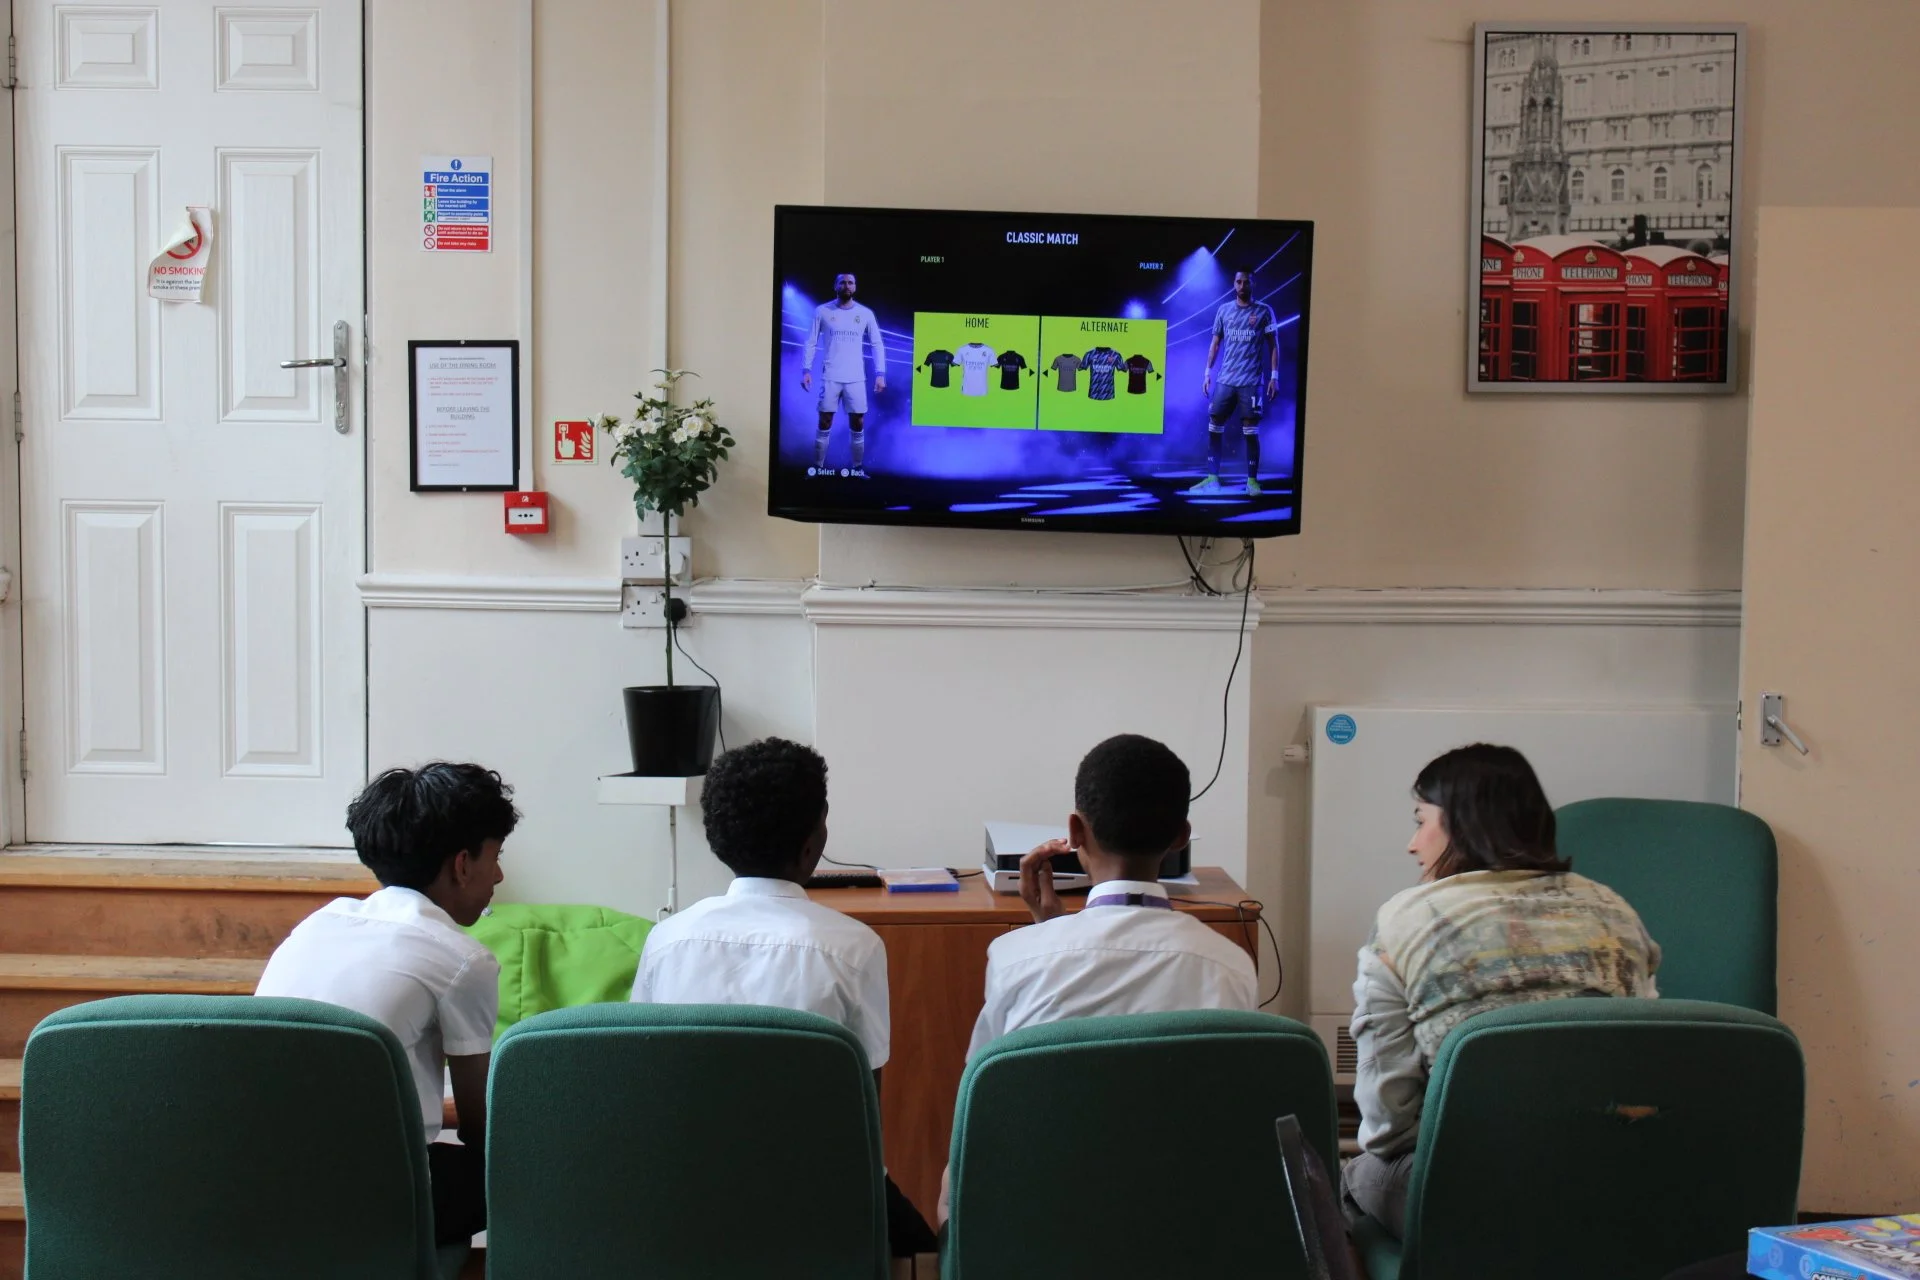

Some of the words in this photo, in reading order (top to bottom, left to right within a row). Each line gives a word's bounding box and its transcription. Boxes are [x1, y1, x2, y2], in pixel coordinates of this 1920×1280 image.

[430, 174, 449, 182] Fire
[451, 174, 482, 183] Action
[1006, 232, 1044, 244] CLASSIC
[1046, 232, 1079, 244] MATCH
[154, 266, 166, 275] NO
[1516, 268, 1542, 279] PHONE
[1564, 268, 1616, 278] TELEPHONE
[1669, 276, 1712, 286] TELEPHONE
[965, 318, 989, 328] HOME
[1080, 321, 1129, 333] ALTERNATE
[1251, 396, 1263, 409] 14
